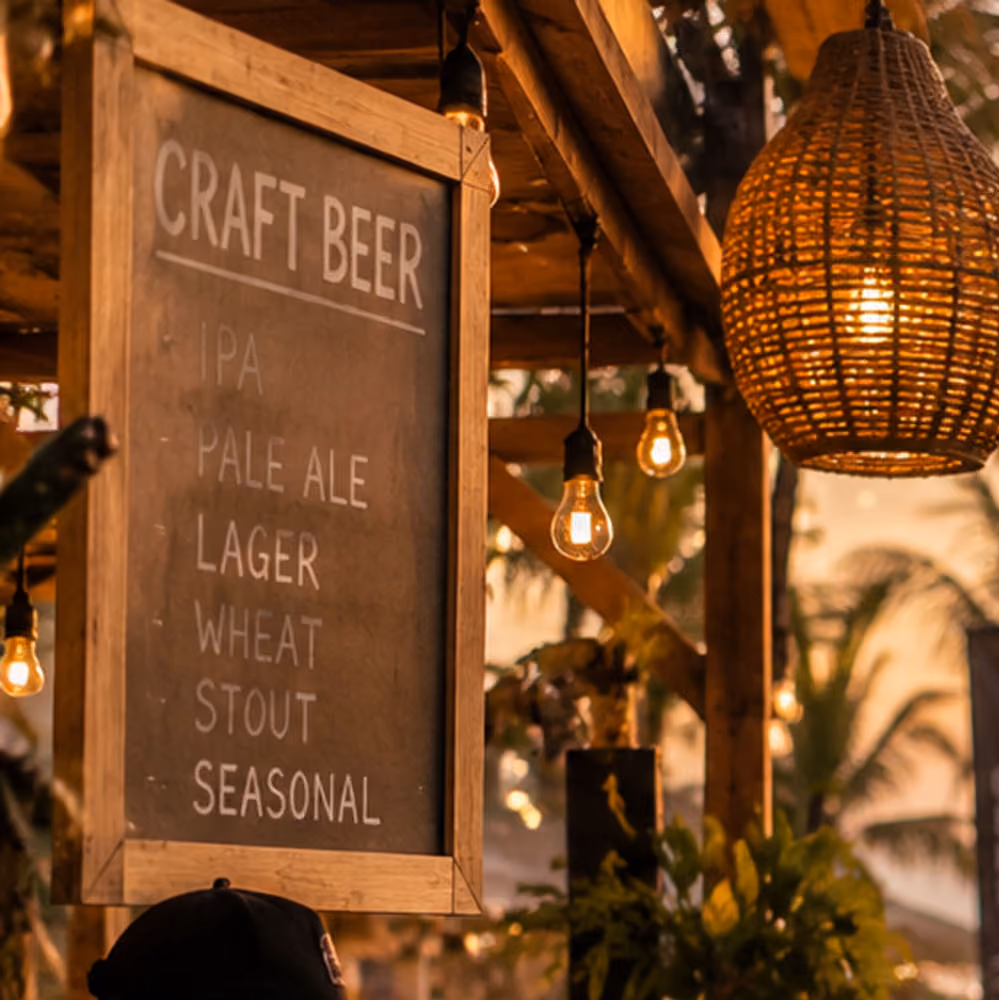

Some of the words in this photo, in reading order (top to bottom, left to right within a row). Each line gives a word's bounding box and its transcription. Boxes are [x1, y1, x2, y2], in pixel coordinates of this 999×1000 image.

[154, 139, 305, 271] CRAFT
[323, 195, 423, 310] BEER
[200, 321, 264, 396] IPA
[198, 423, 285, 493] PALE
[303, 446, 369, 509] ALE
[197, 513, 320, 590] LAGER
[194, 599, 323, 670] WHEAT
[195, 677, 317, 744] STOUT
[193, 759, 381, 826] SEASONAL
